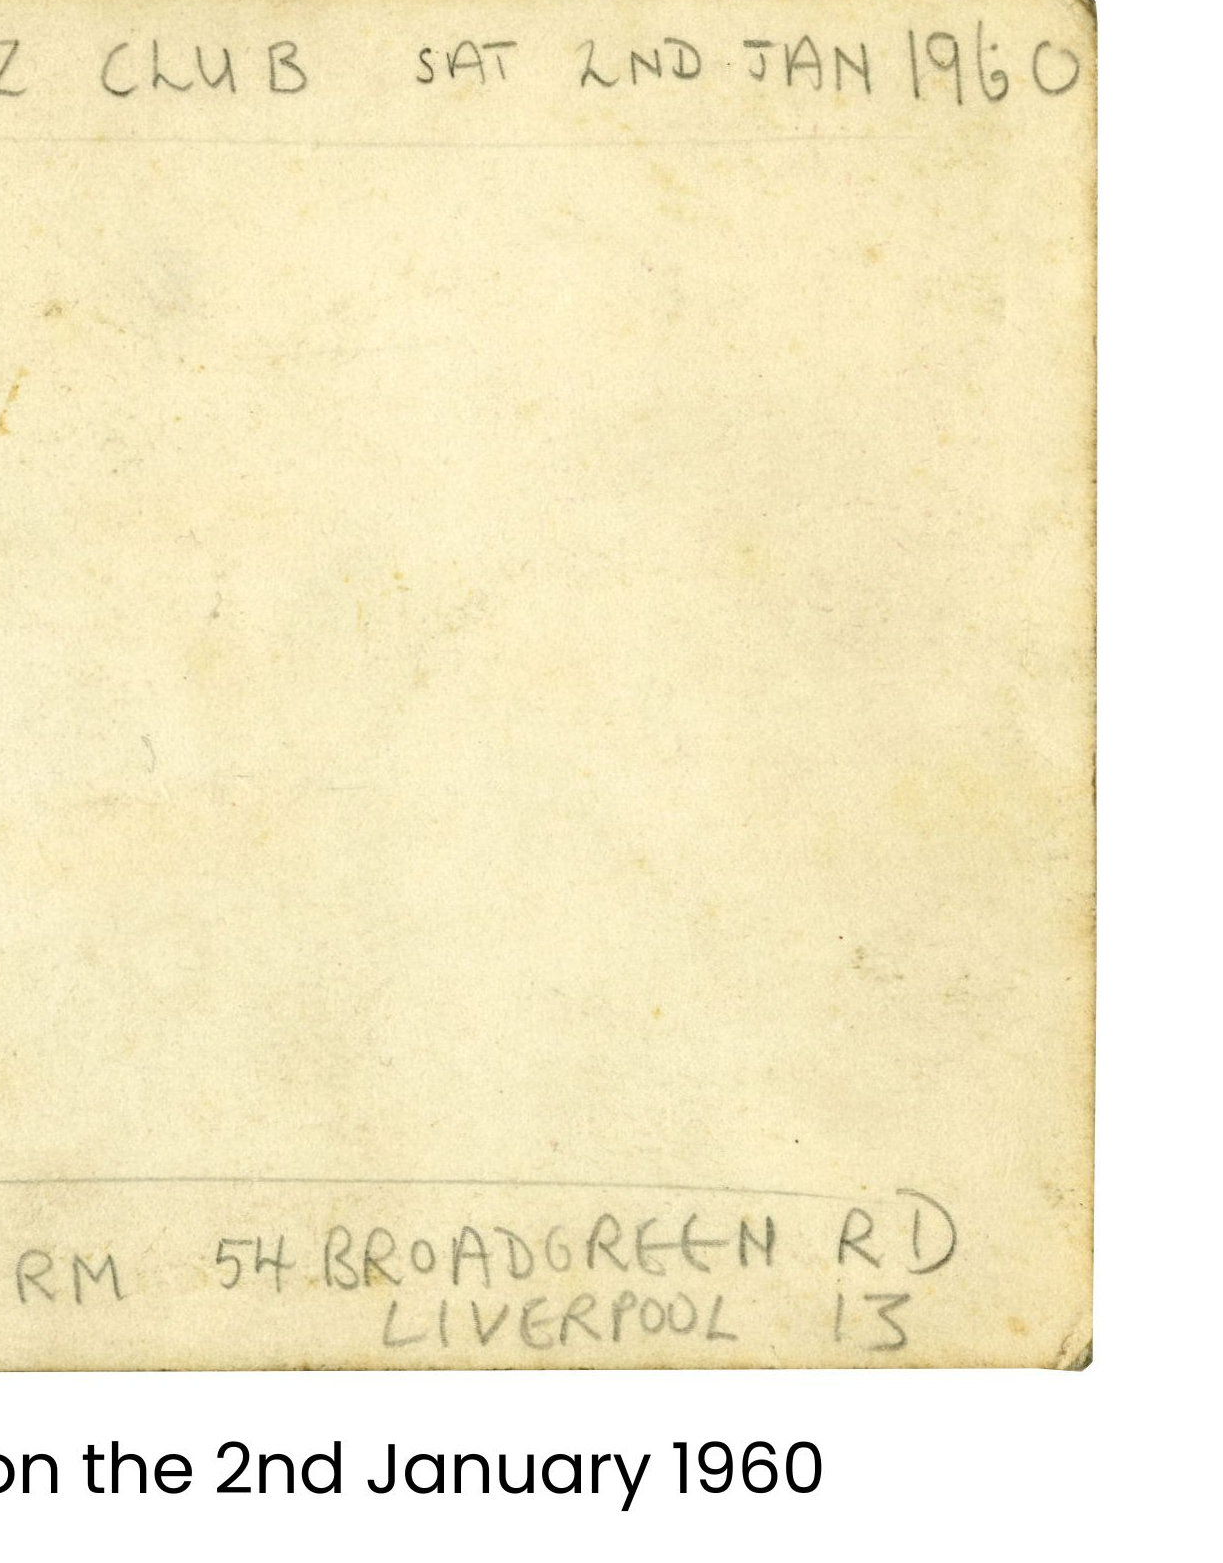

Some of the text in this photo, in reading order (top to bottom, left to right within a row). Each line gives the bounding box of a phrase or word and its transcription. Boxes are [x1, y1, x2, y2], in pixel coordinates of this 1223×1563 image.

[100, 39, 308, 99] CLUB
[415, 40, 518, 85] SAT
[576, 36, 702, 88] 2ND
[742, 34, 872, 95] JAN
[907, 26, 1081, 107] 1960
[215, 1235, 295, 1293] 54
[323, 1213, 777, 1291] BROADGREEN
[837, 1187, 958, 1275] RD
[382, 1291, 911, 1354] LIVERPOOL 13
